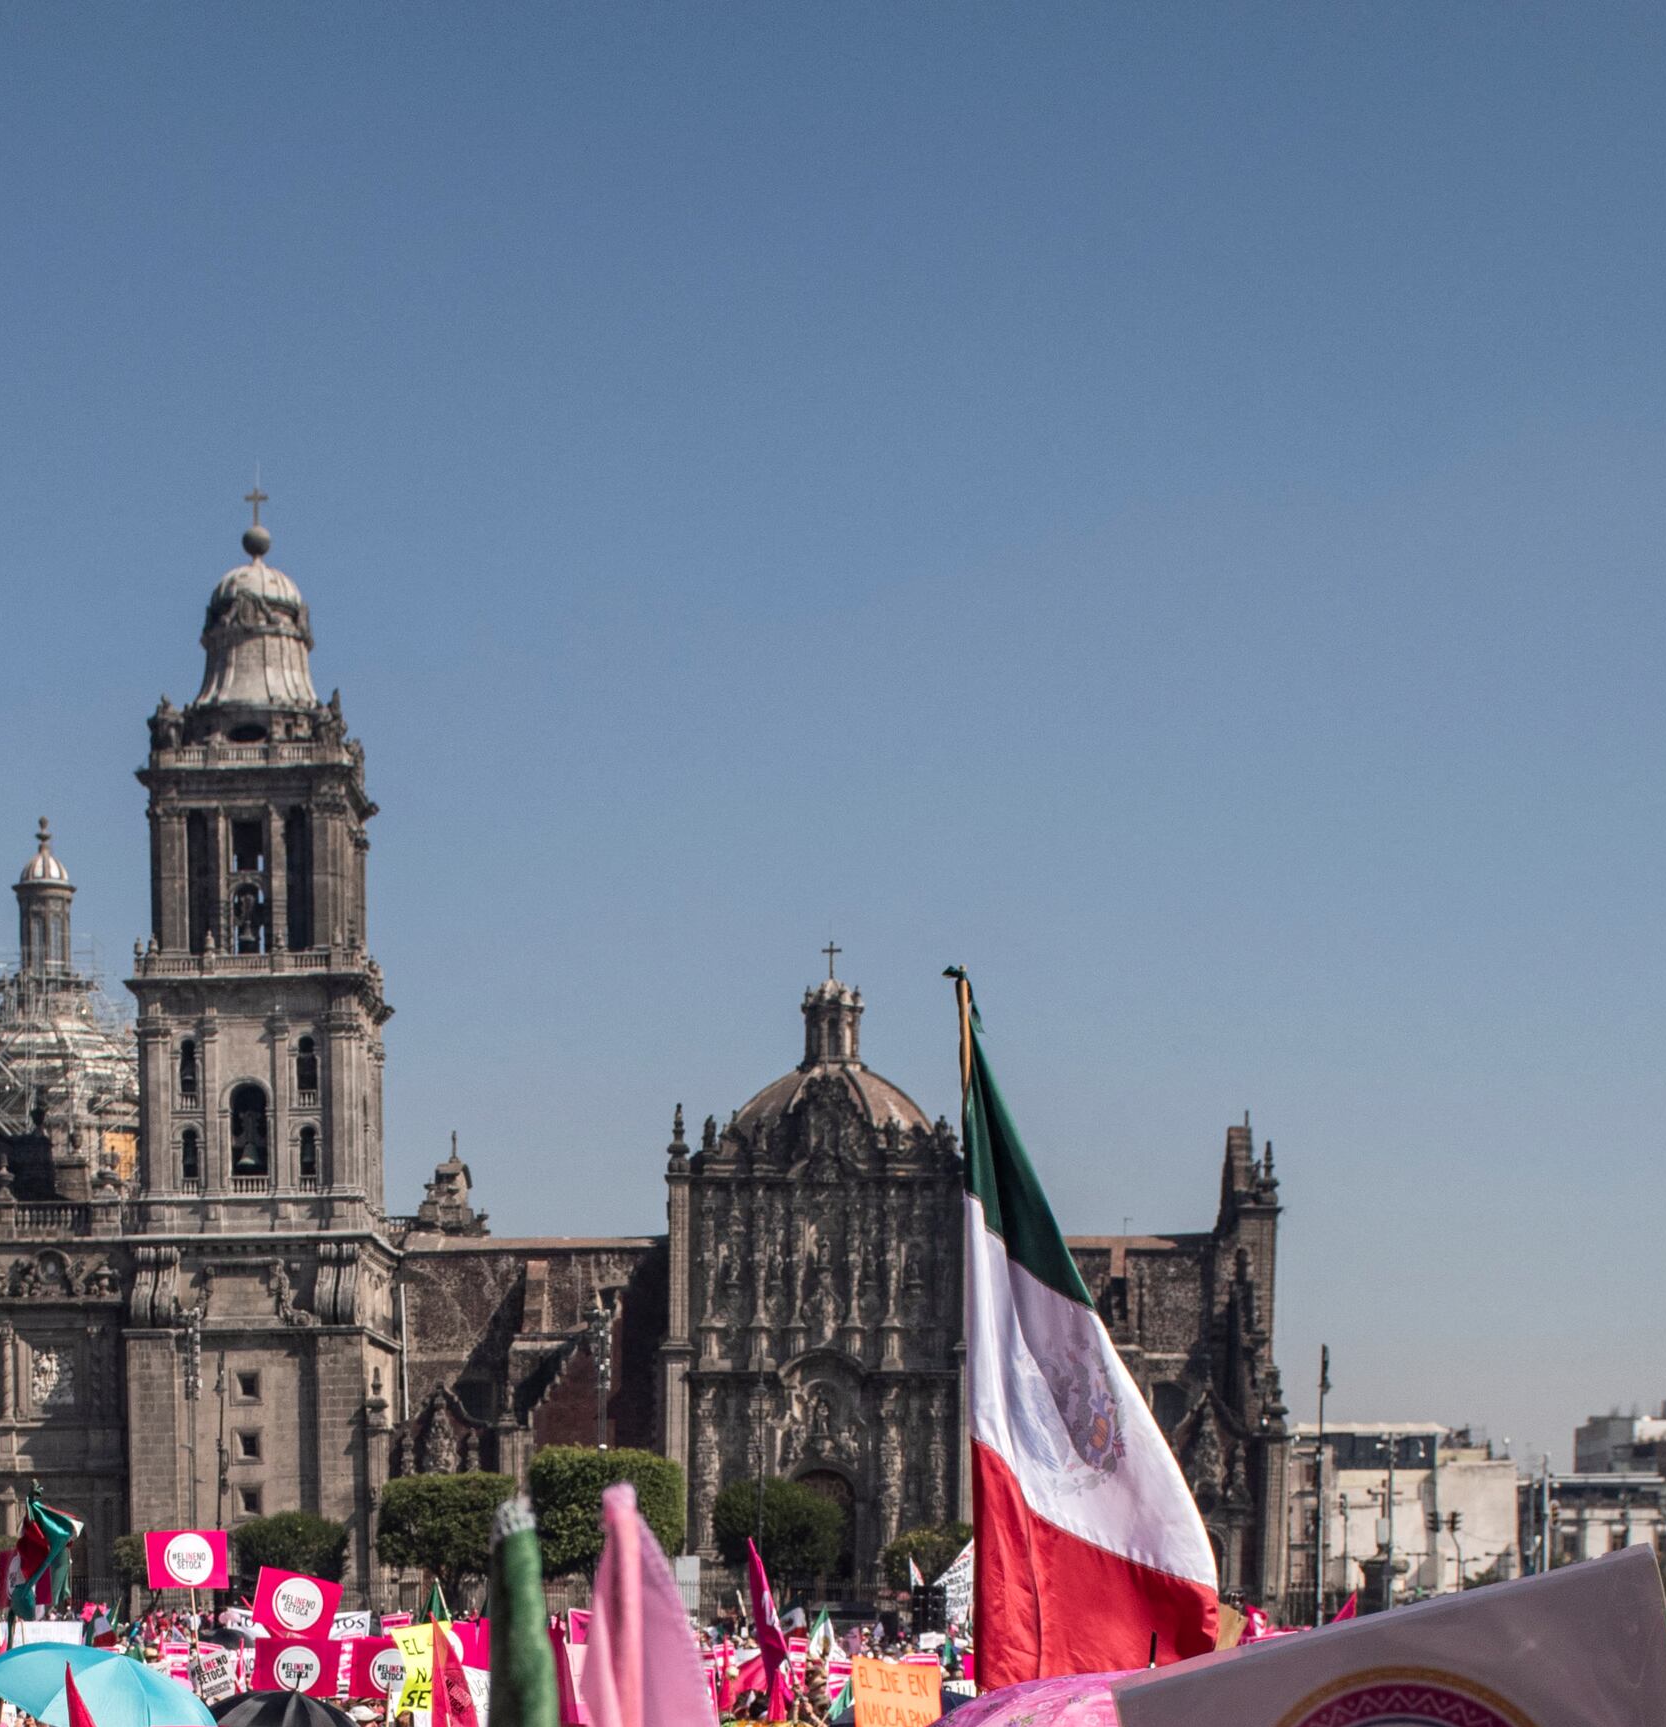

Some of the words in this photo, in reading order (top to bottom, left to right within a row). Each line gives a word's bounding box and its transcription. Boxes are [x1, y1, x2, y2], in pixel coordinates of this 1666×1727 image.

[172, 1552, 206, 1561] #ELINENO
[177, 1560, 201, 1569] SETOCA
[281, 1595, 316, 1609] #ELINENO
[283, 1602, 308, 1616] SETOCA
[282, 1662, 314, 1672] #ELINENO
